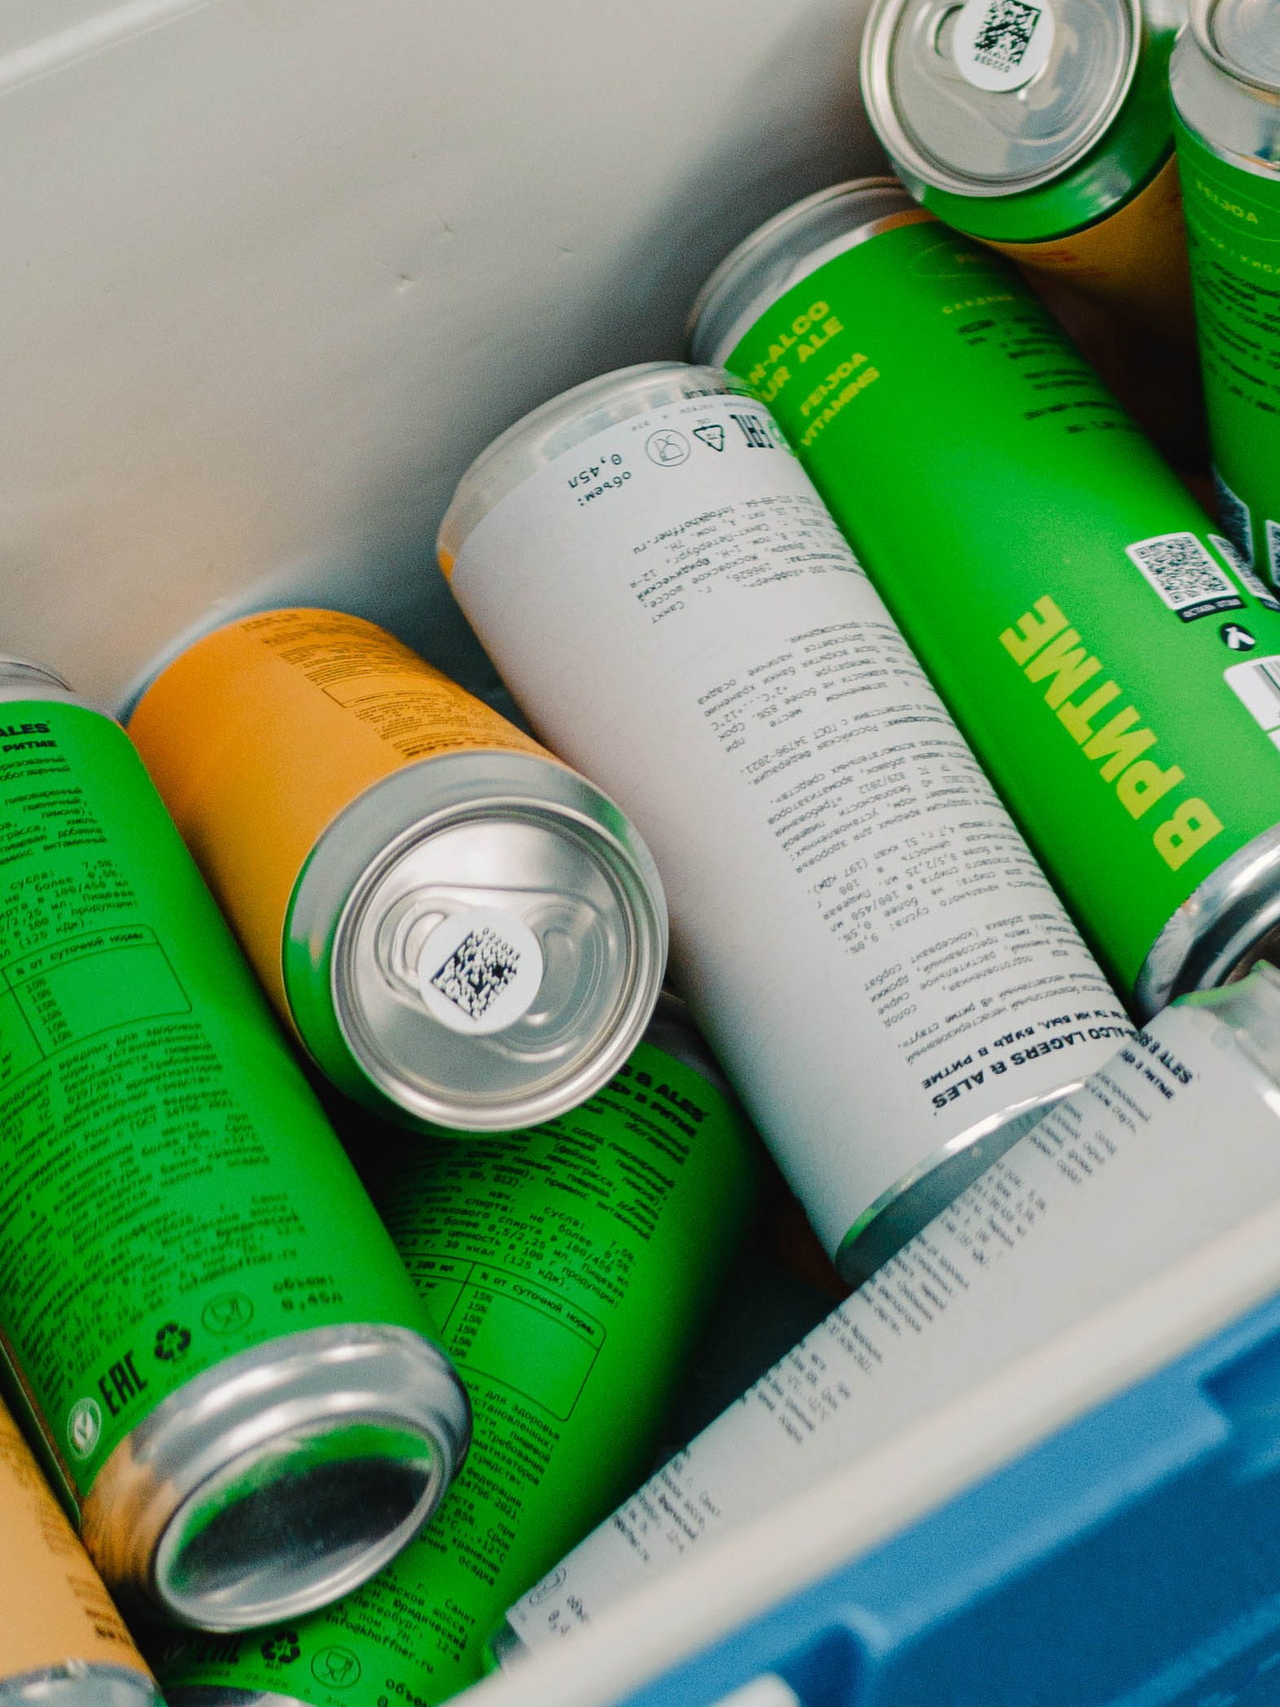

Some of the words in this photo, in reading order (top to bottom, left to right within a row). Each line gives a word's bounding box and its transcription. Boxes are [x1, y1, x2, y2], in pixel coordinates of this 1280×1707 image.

[745, 298, 832, 386] N-ALCO
[757, 364, 794, 403] UR
[792, 315, 844, 363] ALE
[798, 349, 868, 416] FEIJOA
[797, 365, 881, 447] VITAMINS
[565, 452, 623, 490] 0,45л
[575, 469, 633, 507] объем:
[631, 503, 735, 556] info@khoffner.ru
[664, 519, 770, 568] Санкт-Петербург,
[633, 555, 712, 602] Юридический
[641, 583, 685, 611] шоссе,
[648, 599, 685, 625] Санкт
[745, 650, 793, 677] наличие
[761, 664, 796, 687] банки
[694, 677, 738, 707] осадка
[701, 683, 757, 718] хранению
[782, 685, 817, 707] более
[999, 594, 1185, 821] РИТМЕ
[716, 720, 746, 743] Срок
[767, 707, 803, 729] месте
[812, 722, 837, 739] ГОСТ
[723, 736, 747, 754] при
[765, 773, 854, 826] ароматизаторов
[779, 818, 827, 851] пищевой
[851, 825, 873, 843] для
[1153, 797, 1224, 872] В
[793, 838, 849, 875] здоровья
[841, 856, 868, 879] (197
[872, 842, 899, 862] ккал
[820, 887, 872, 922] Пищевая
[881, 895, 919, 919] более
[888, 905, 931, 934] сусла:
[828, 920, 845, 934] мл
[907, 925, 979, 966] (консервант
[861, 961, 904, 992] сорбат
[918, 949, 997, 992] растительное
[881, 1003, 919, 1029] солод
[1036, 1013, 1070, 1031] БЫЛ,
[977, 1045, 989, 1057] В
[992, 1025, 1035, 1049] БУДЬ
[1008, 1028, 1086, 1067] LAGERS
[919, 1053, 973, 1089] РИТМЕ
[989, 1059, 1007, 1076] &
[634, 1092, 647, 1104] В
[529, 1212, 544, 1224] не
[556, 1222, 594, 1248] более
[542, 1204, 586, 1231] сусла:
[502, 1252, 532, 1273] (125
[493, 1276, 507, 1287] от
[511, 1283, 564, 1314] суточной
[97, 1350, 147, 1413] EAC
[484, 1388, 508, 1406] для
[510, 1402, 563, 1441] здоровья
[484, 1529, 512, 1552] Срок
[495, 1521, 517, 1539] при
[449, 1536, 502, 1574] хранению
[456, 1554, 497, 1586] осадка
[390, 1598, 467, 1651] Юридический
[442, 1597, 478, 1625] Санкт
